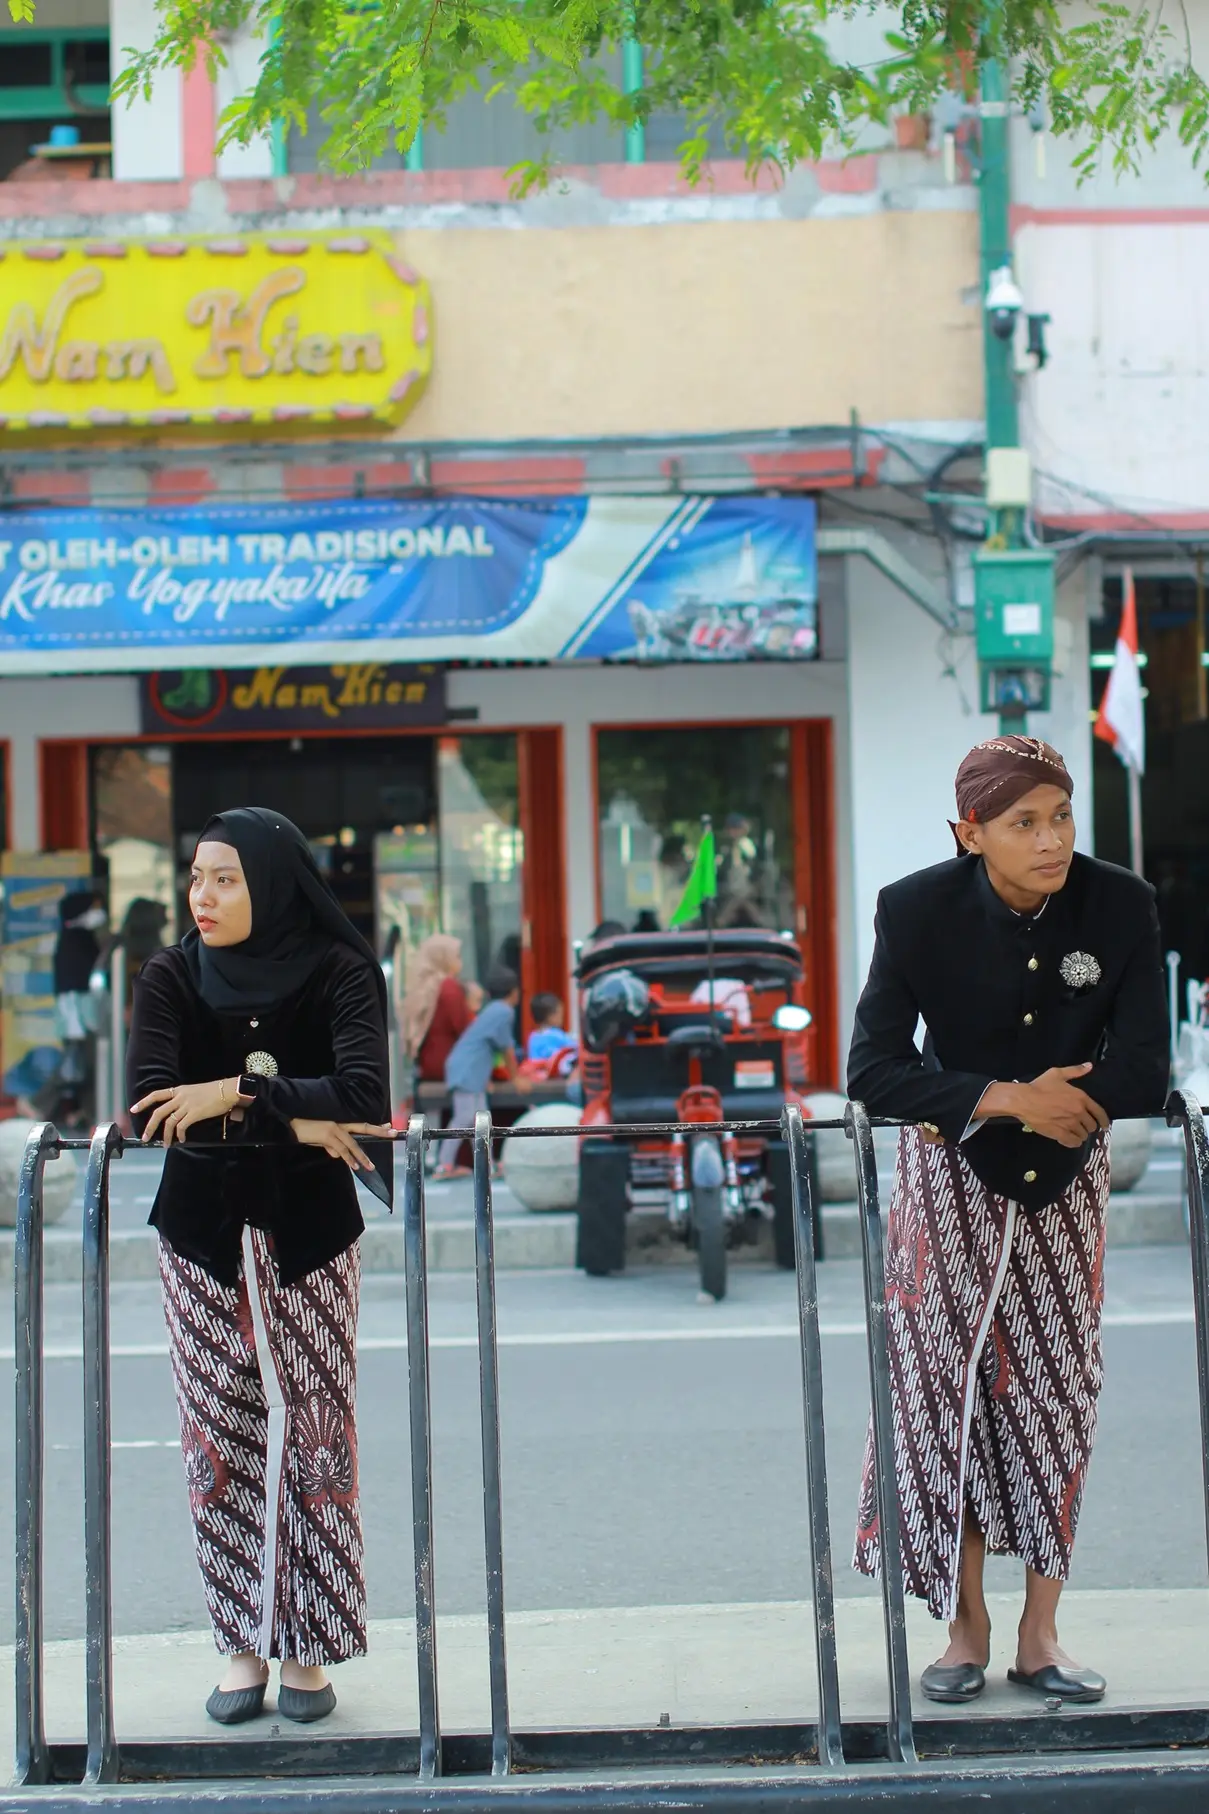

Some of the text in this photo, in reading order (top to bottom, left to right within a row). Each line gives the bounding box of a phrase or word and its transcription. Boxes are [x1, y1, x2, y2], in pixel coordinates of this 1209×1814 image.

[0, 265, 384, 394] Nam Hien
[19, 534, 229, 571] OLEH-OLEH
[236, 525, 495, 564] TRADISIONAL
[0, 569, 115, 622] Khas
[232, 662, 427, 717] Nam Hien
